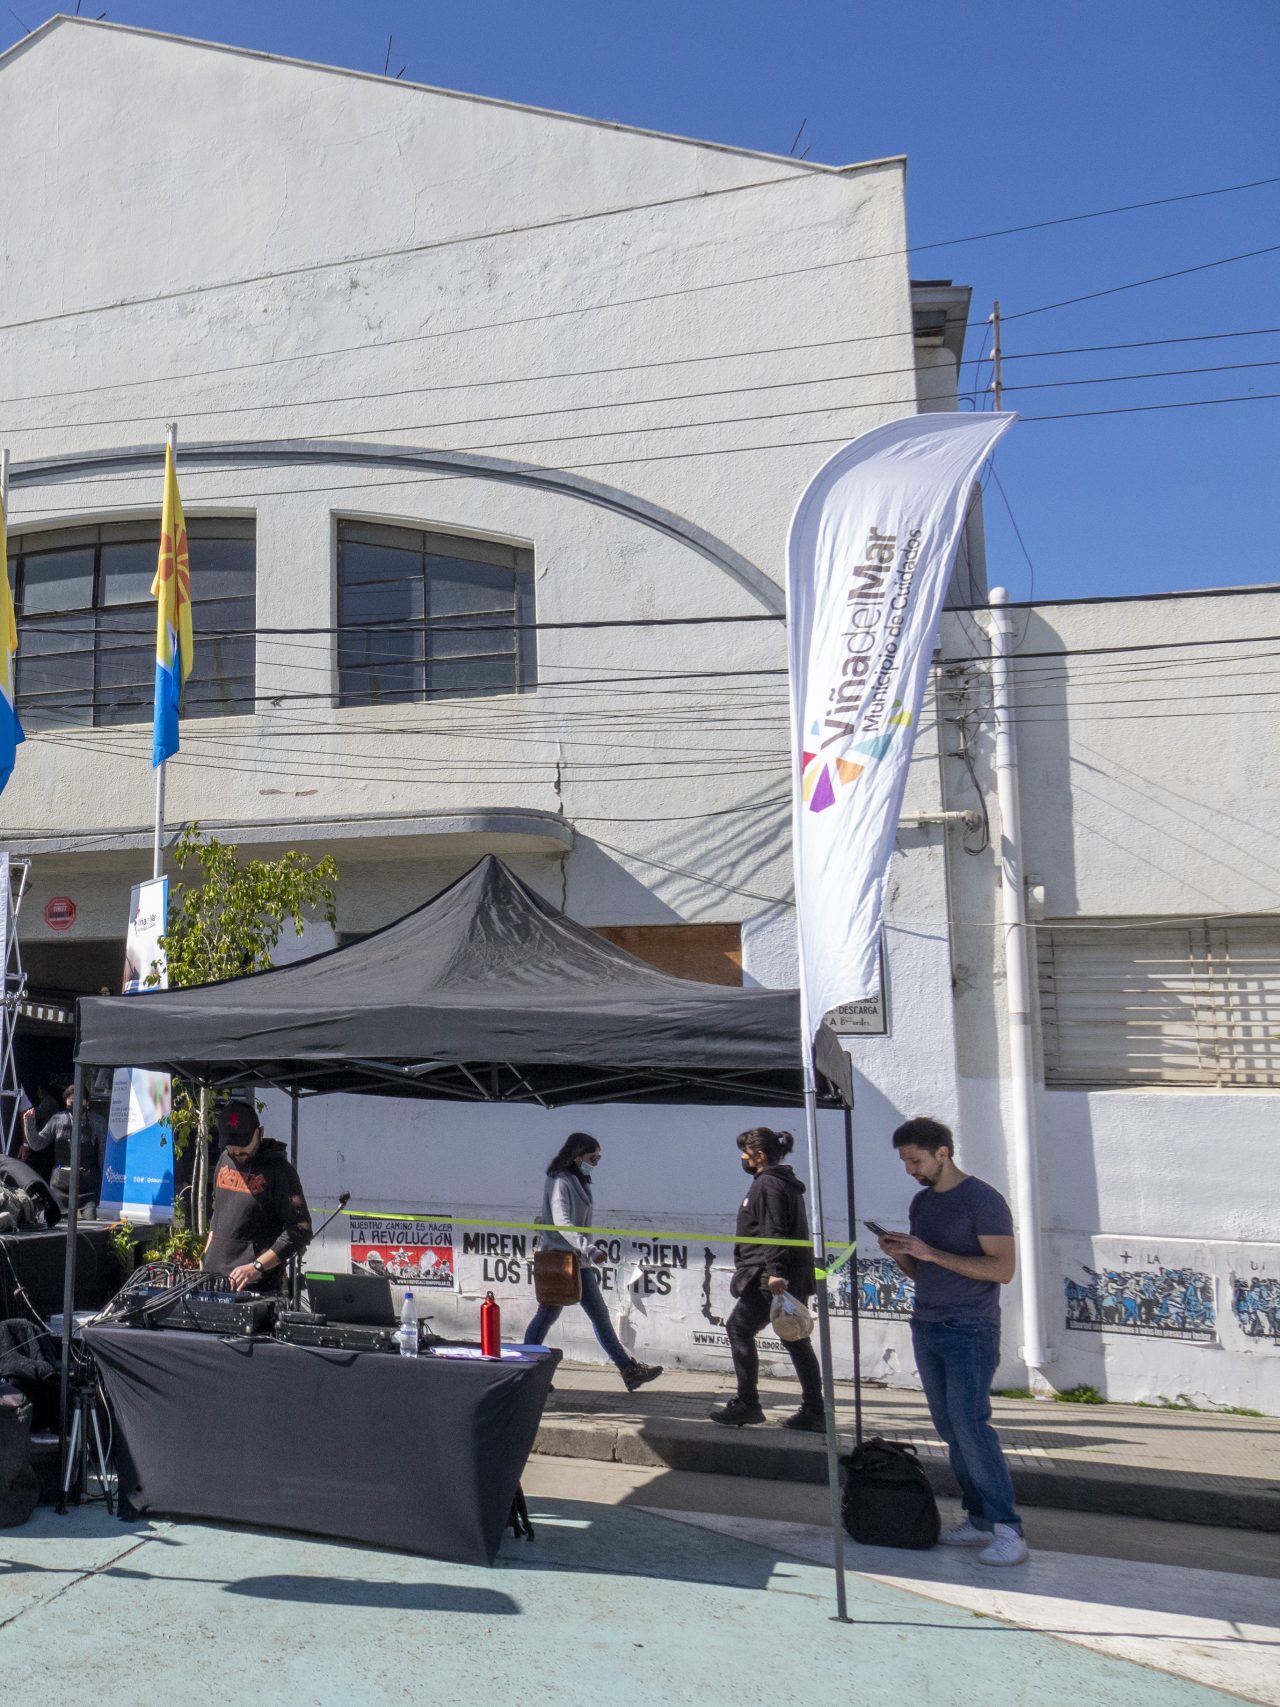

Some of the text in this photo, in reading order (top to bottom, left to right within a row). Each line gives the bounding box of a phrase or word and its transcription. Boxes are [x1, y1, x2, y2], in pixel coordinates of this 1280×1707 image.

[861, 528, 922, 732] Municipio de Cuidados
[838, 1005, 878, 1015] DESCARGA
[350, 1221, 382, 1230] NUESTRO
[416, 1223, 425, 1231] ES
[428, 1223, 452, 1232] HACER
[350, 1230, 365, 1243] LA
[462, 1232, 526, 1258] MIREN
[597, 1237, 688, 1269] SORÍEN
[483, 1258, 520, 1284] LOS
